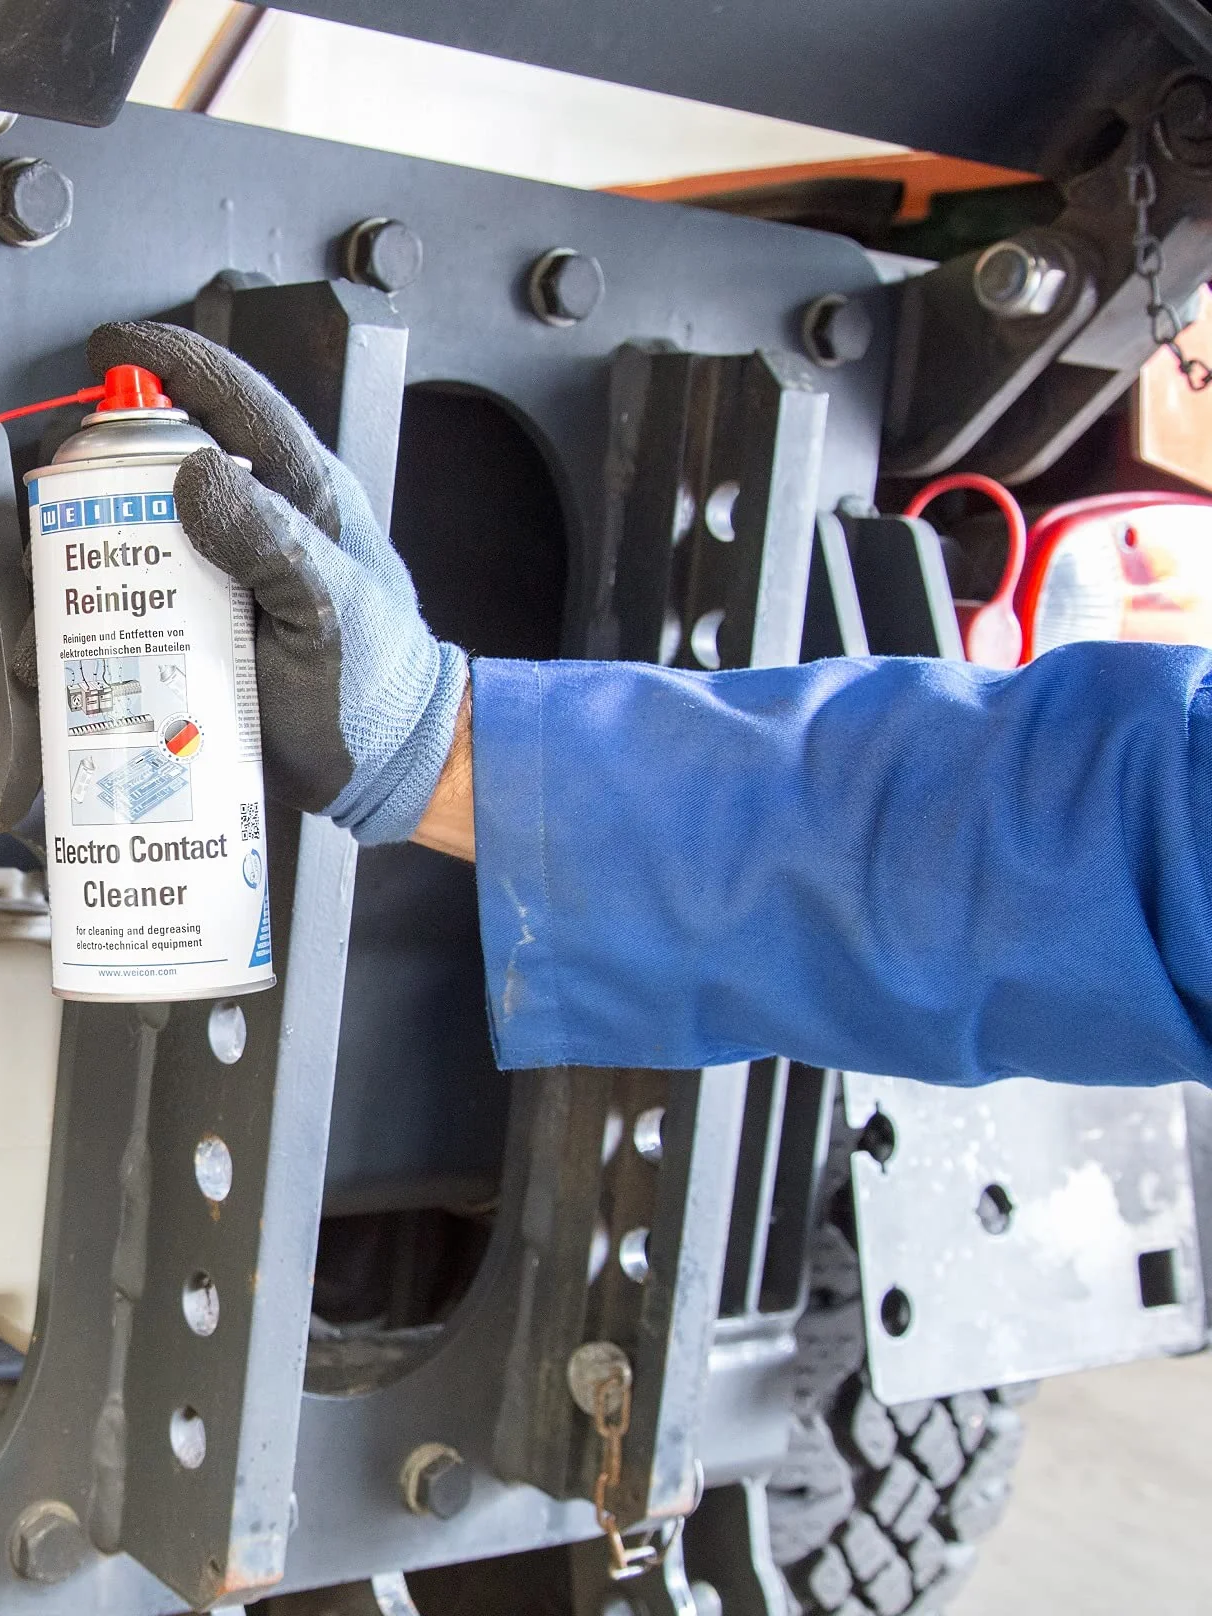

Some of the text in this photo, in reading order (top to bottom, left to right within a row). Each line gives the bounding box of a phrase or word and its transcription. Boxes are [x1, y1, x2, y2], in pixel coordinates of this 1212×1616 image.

[42, 499, 168, 528] WEICO
[65, 540, 172, 571] Elektro-
[65, 584, 177, 617] Reiniger
[62, 629, 184, 645] Reinigen und Entfetten von
[59, 642, 191, 659] elektrotechnischen Bauteilen
[55, 834, 228, 864] Electro Contact
[83, 880, 187, 908] Cleaner
[76, 923, 201, 937] for cleaning and degreasing
[76, 938, 203, 951] electro-technical equipment
[98, 967, 177, 977] www.weicon.com
